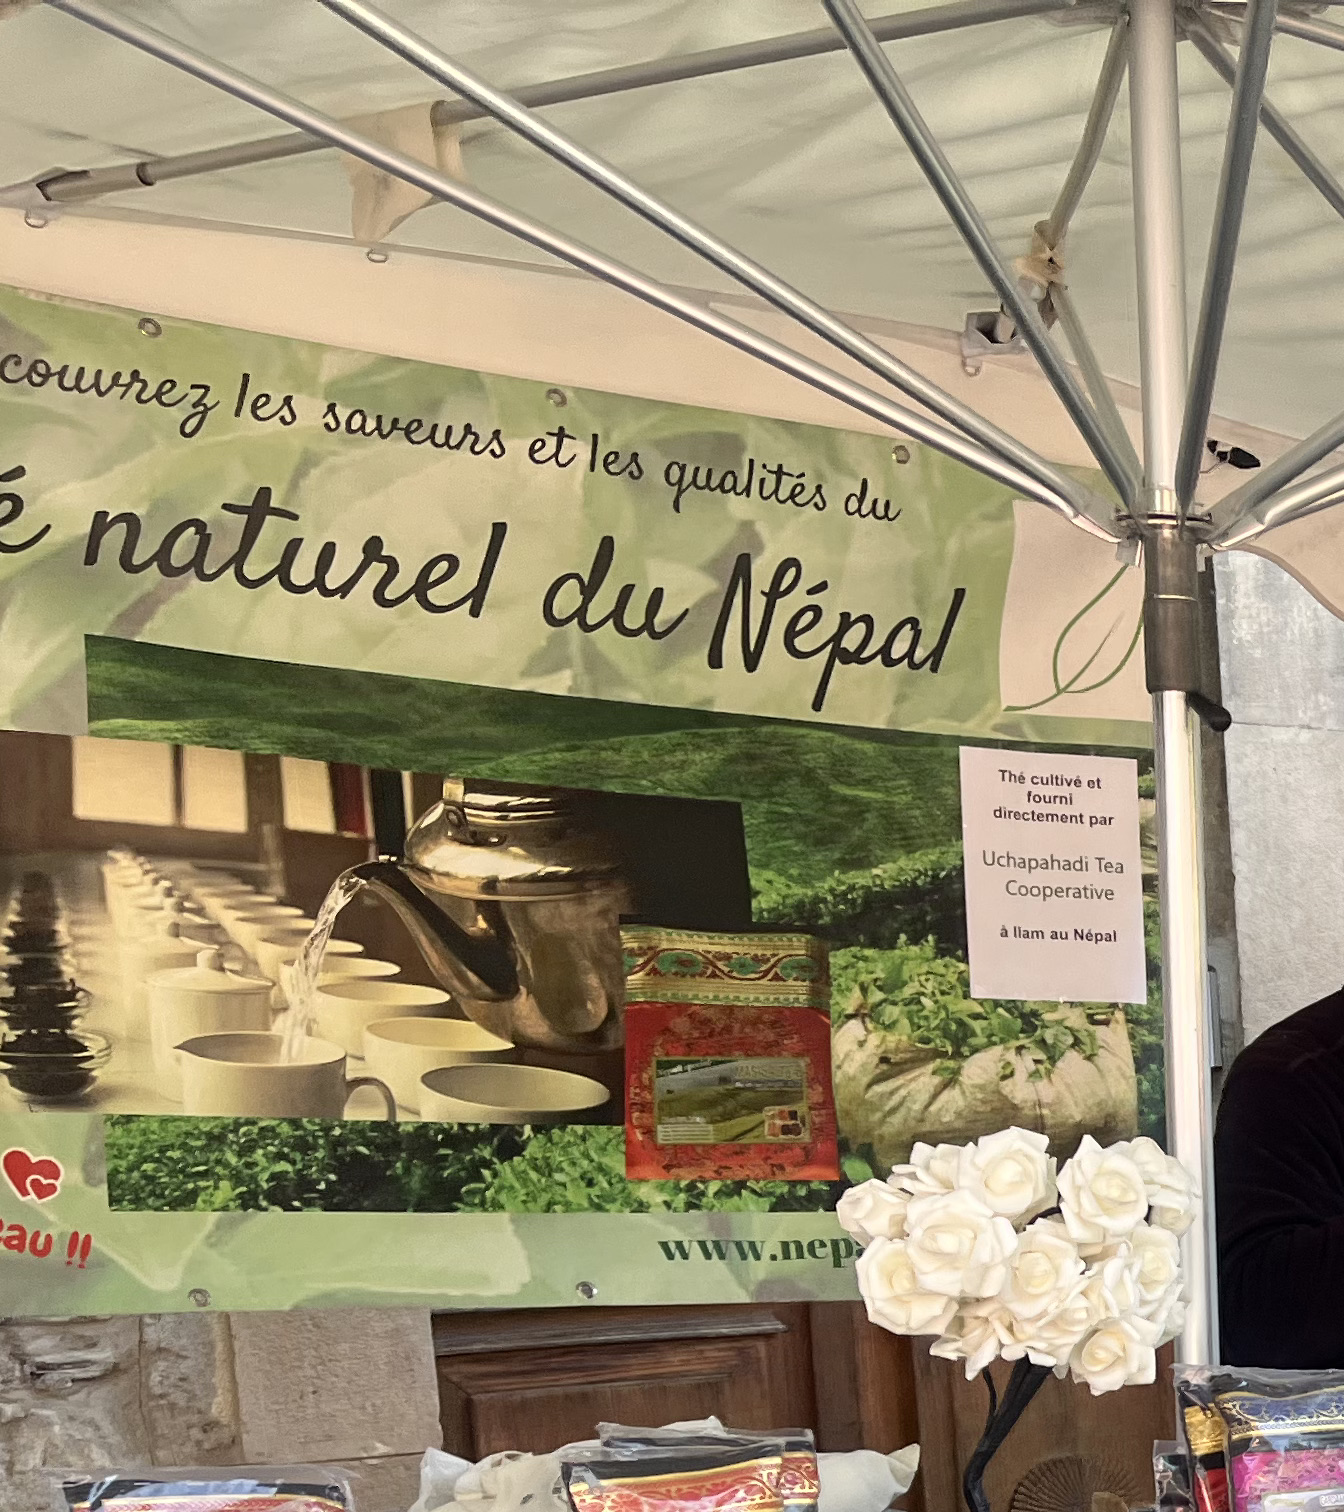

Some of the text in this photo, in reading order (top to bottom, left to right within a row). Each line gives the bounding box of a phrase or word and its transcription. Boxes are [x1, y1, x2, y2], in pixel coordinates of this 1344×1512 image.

[234, 373, 297, 426] les
[322, 402, 506, 460] saveurs
[528, 426, 577, 469] et
[590, 434, 644, 479] les
[664, 459, 827, 514] qualités
[843, 478, 902, 521] du
[84, 487, 507, 619] naturel
[541, 535, 690, 640] du
[707, 553, 966, 712] Népal
[998, 769, 1102, 789] Thé cultivé et
[1027, 791, 1073, 806] fourni
[993, 806, 1115, 828] directement par
[982, 849, 1125, 874] Uchapahadi Tea
[1005, 879, 1115, 902] Cooperative
[1000, 924, 1009, 939] à
[1050, 929, 1069, 941] au
[1073, 927, 1117, 945] Népal
